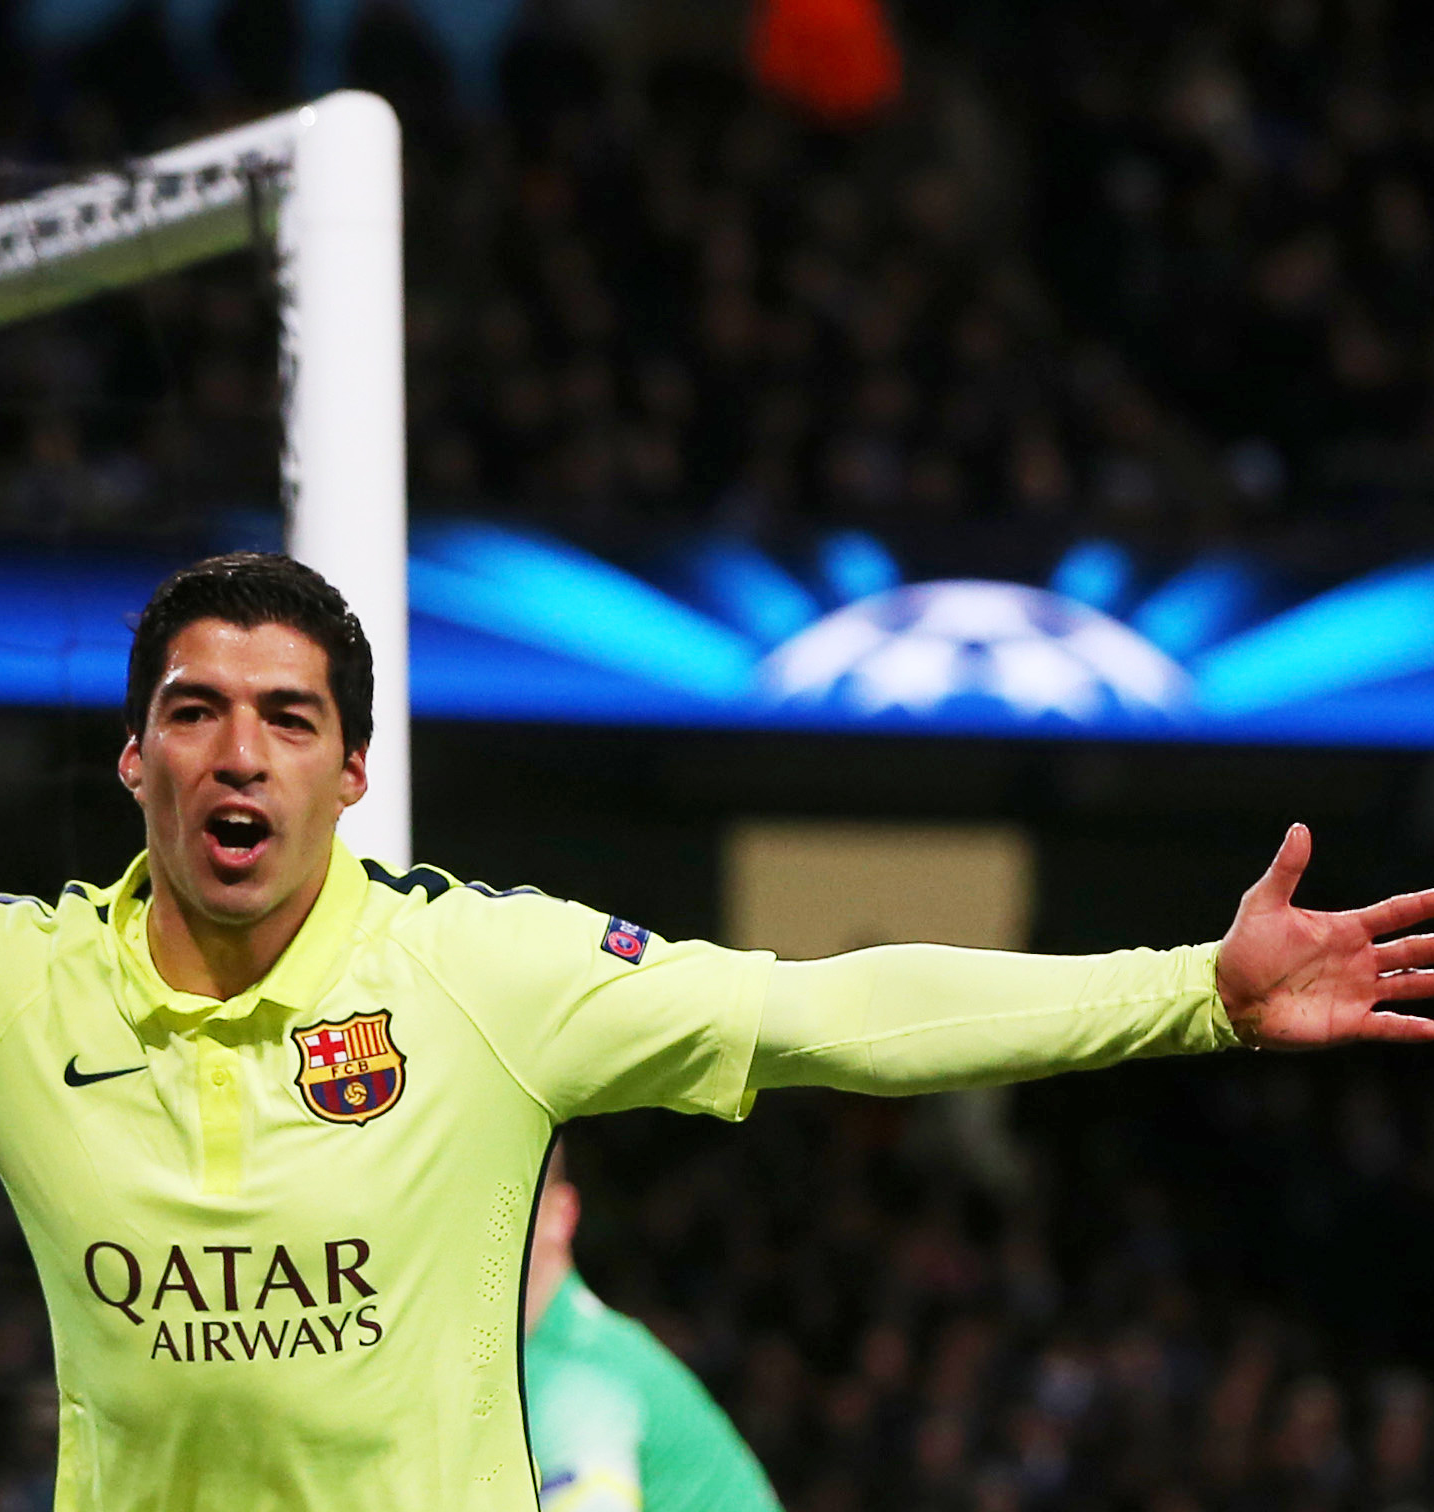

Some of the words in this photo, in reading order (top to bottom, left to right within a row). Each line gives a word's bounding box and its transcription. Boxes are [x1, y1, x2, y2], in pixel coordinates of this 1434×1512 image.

[331, 1060, 369, 1078] FCB
[84, 1238, 378, 1326] QATAR
[151, 1305, 383, 1362] AIRWAYS
